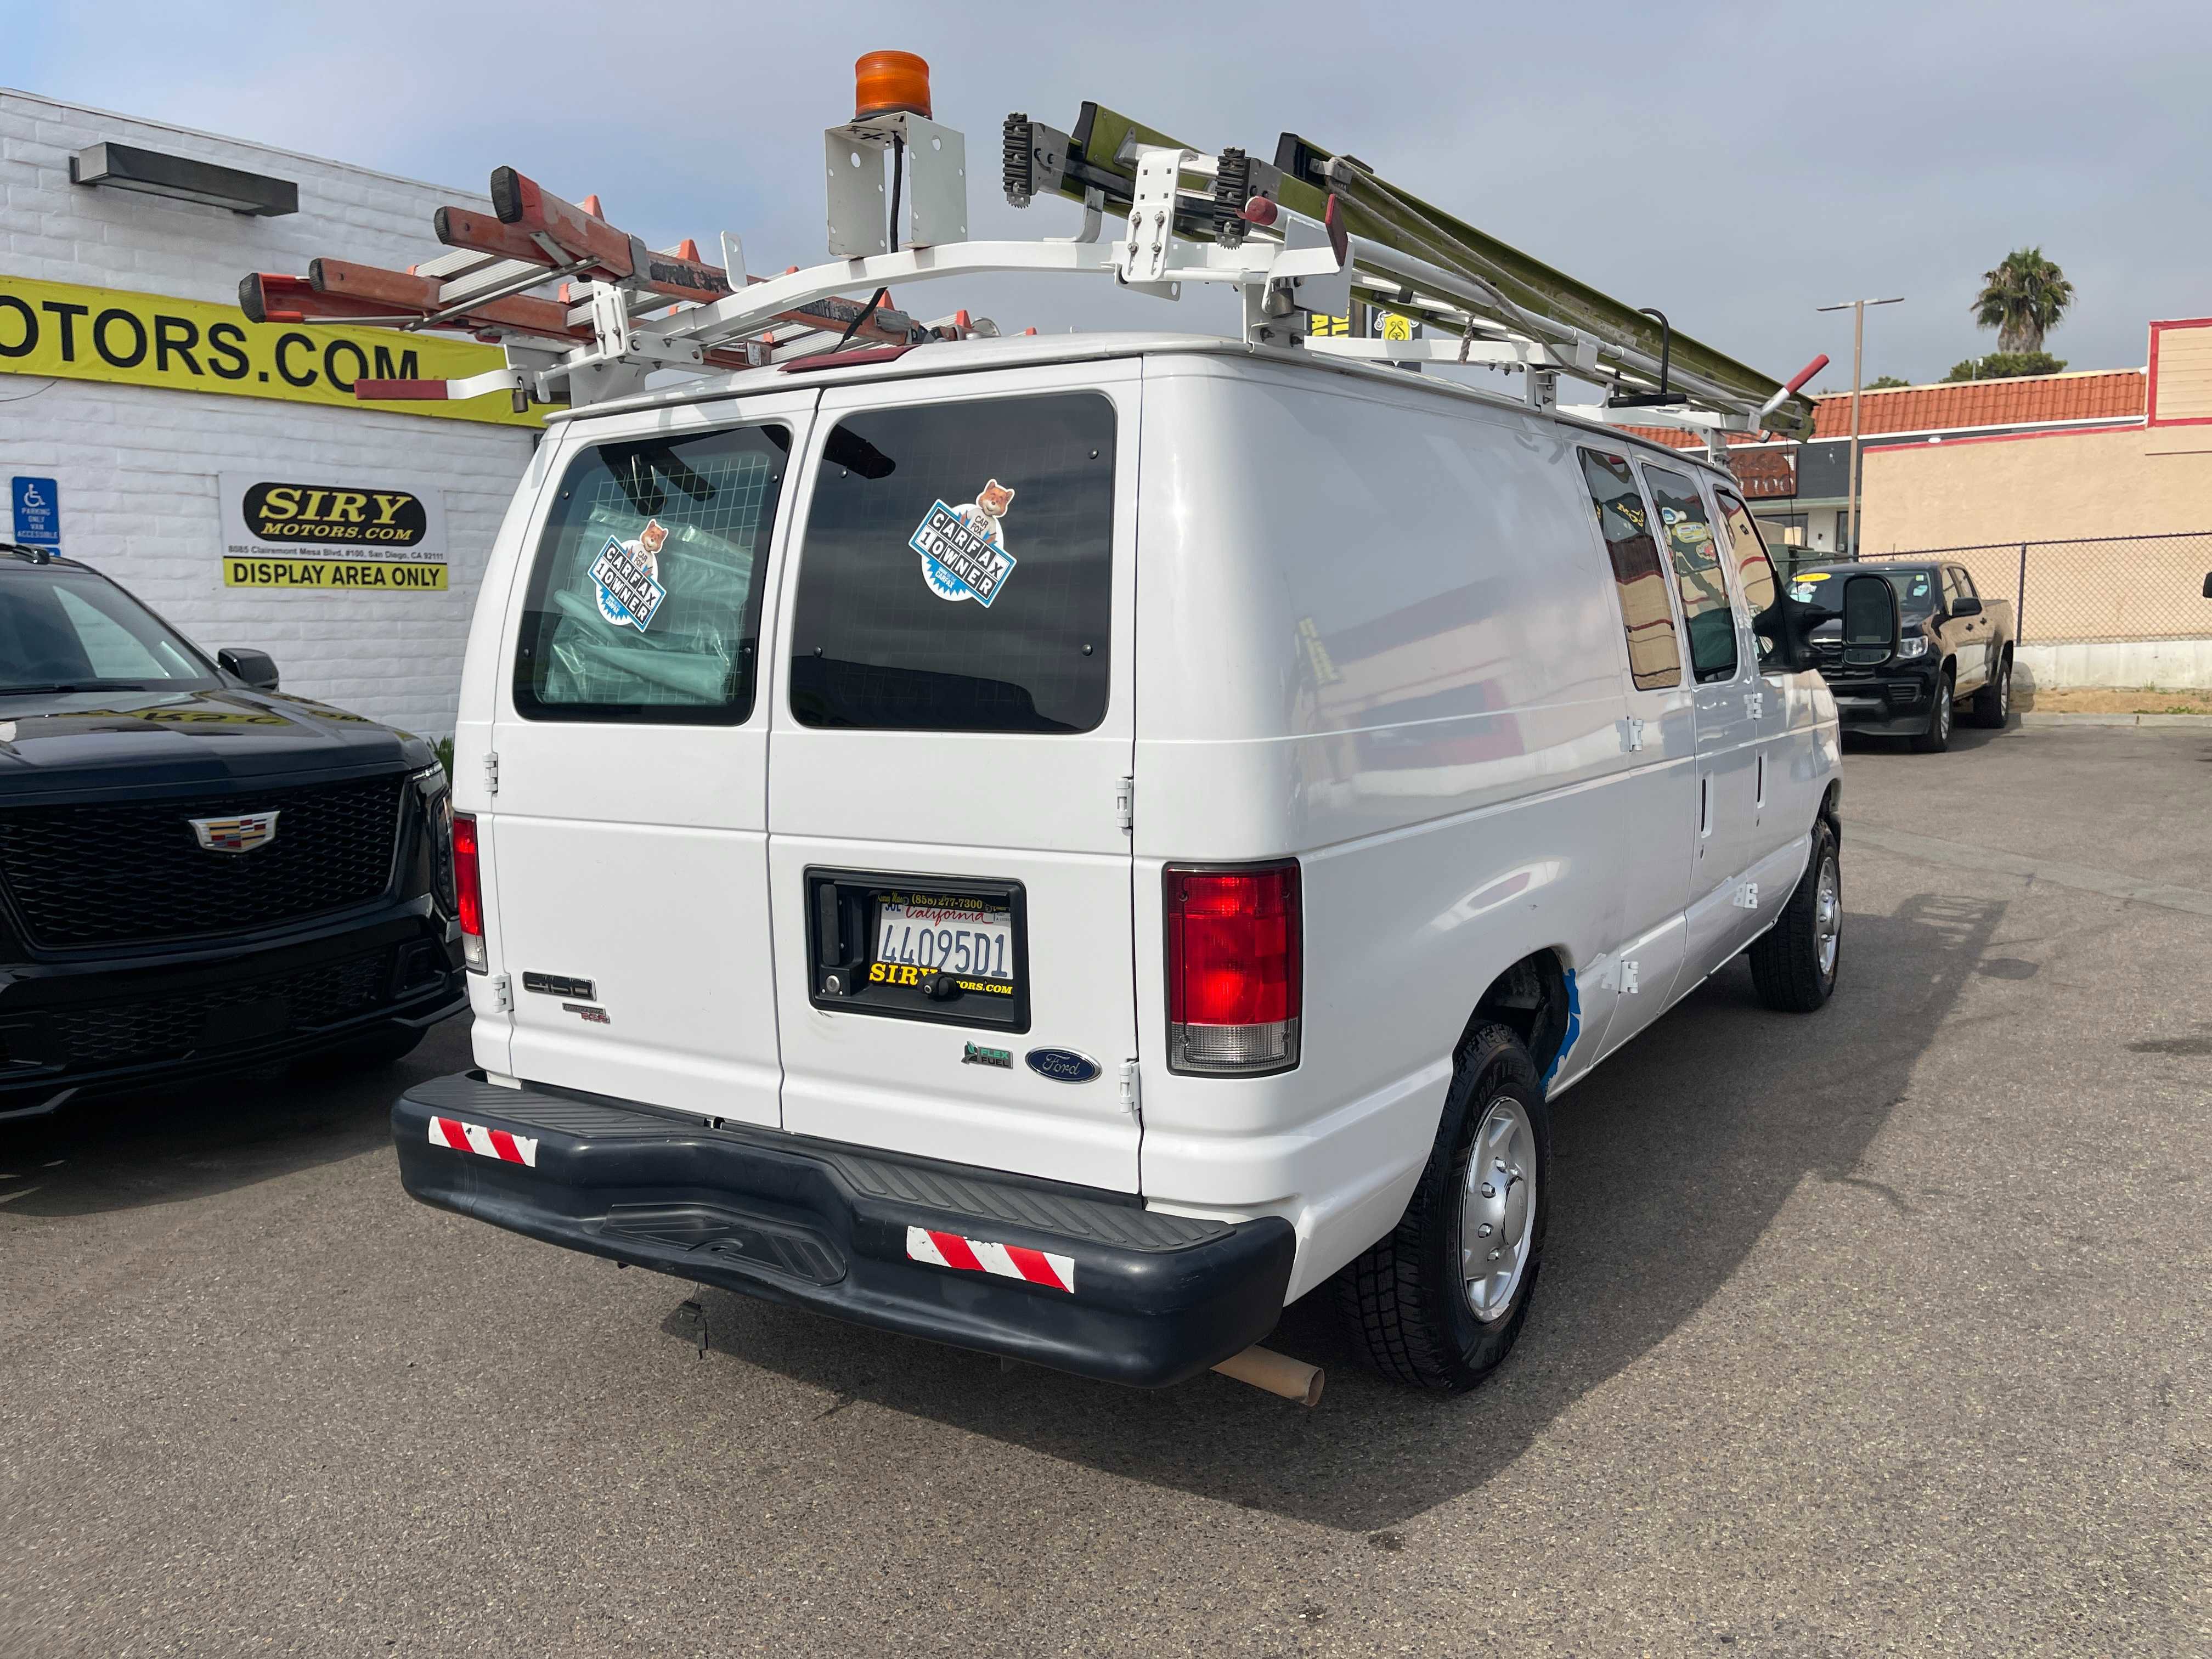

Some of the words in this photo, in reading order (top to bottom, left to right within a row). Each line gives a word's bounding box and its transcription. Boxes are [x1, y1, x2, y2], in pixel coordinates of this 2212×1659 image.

[258, 487, 413, 525] SIRY
[261, 522, 414, 541] MOTORS.COM
[970, 523, 984, 536] FOX
[974, 515, 989, 529] CAR
[251, 545, 297, 555] Clairemont
[300, 547, 320, 556] Mesa
[933, 512, 1003, 579] CARFAX
[634, 557, 644, 569] FOX
[637, 550, 648, 563] CAR
[920, 532, 932, 546] 1
[933, 540, 992, 595] OWNER
[233, 562, 325, 584] DISPLAY
[331, 566, 386, 586] AREA
[391, 567, 440, 586] ONLY
[606, 547, 656, 607] CARFAX
[935, 570, 956, 589] CARFAX
[596, 563, 605, 575] 1
[604, 572, 648, 621] OWNER
[905, 906, 994, 926] California
[882, 924, 1008, 978] 44095D1
[980, 1048, 1009, 1059] FLEX
[980, 1057, 1009, 1067] FUEL
[1042, 1053, 1080, 1075] Ford
